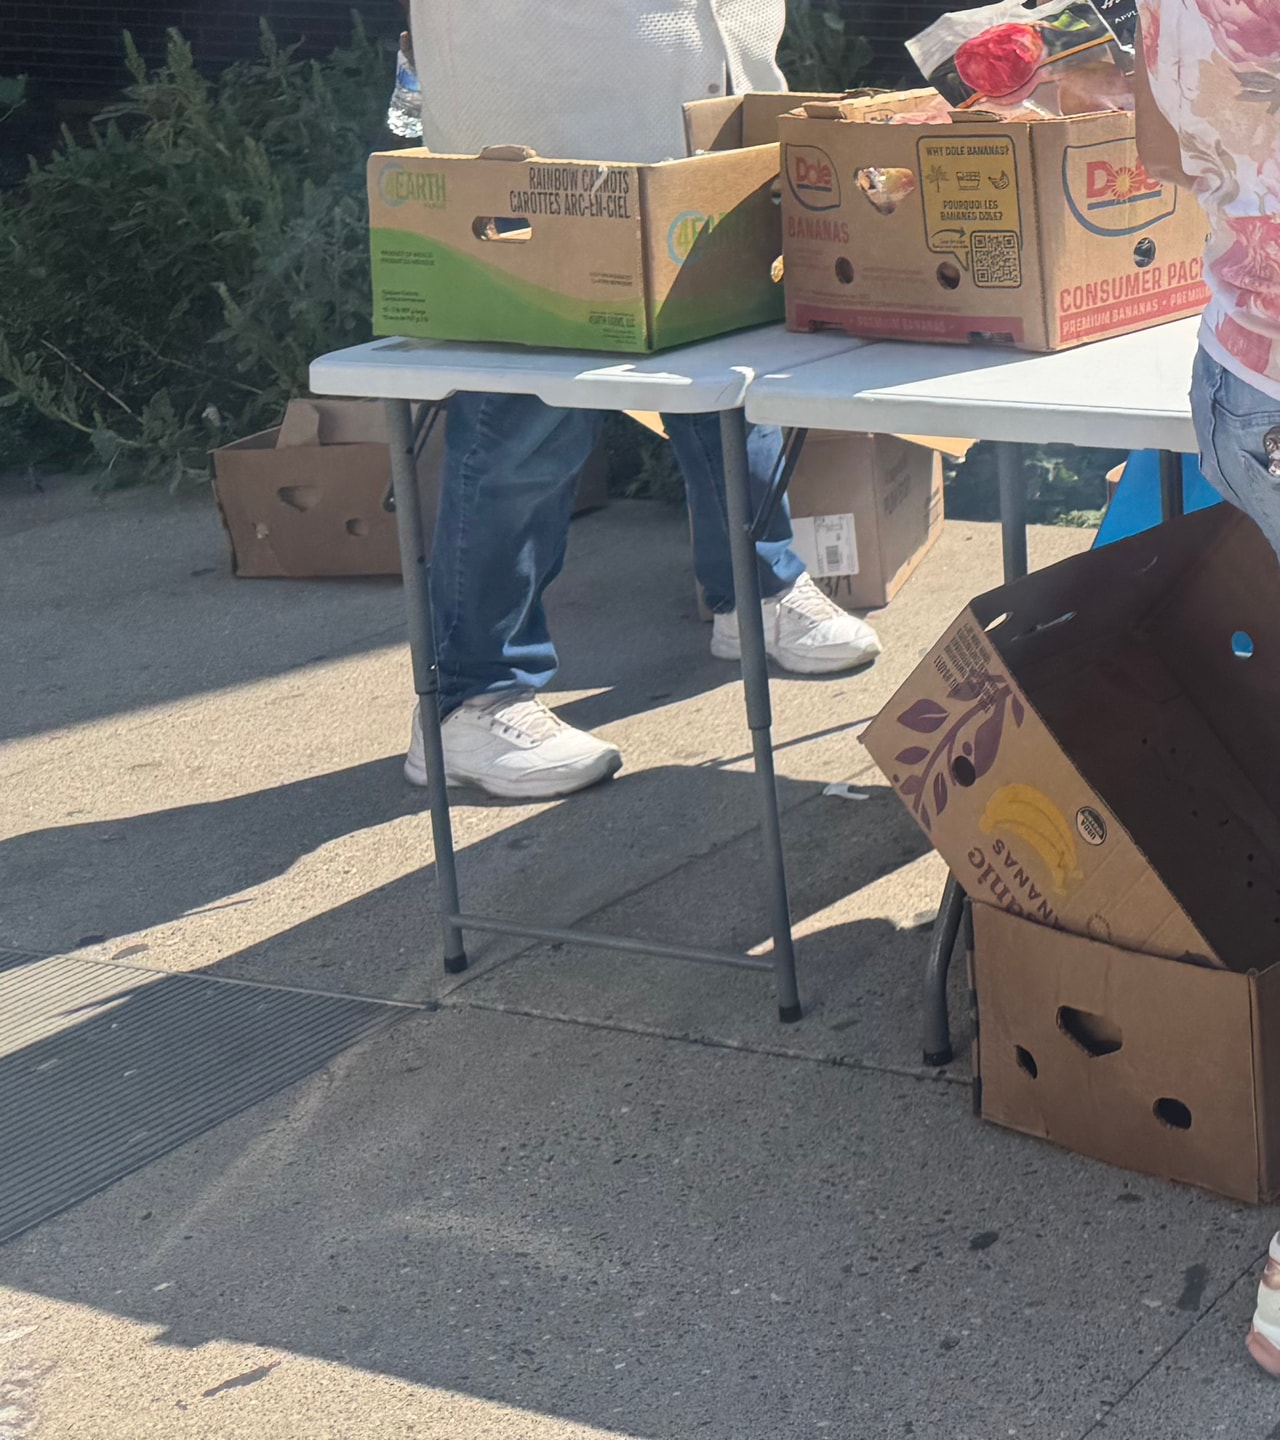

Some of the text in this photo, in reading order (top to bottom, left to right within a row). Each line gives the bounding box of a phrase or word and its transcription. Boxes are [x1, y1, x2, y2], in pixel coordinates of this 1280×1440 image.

[926, 145, 1010, 156] WHY DOLE BANANAS?
[529, 167, 580, 192] RAINBOW
[795, 156, 832, 187] Dole
[510, 190, 631, 219] CAROTTES ARC-EN-CIEL
[984, 199, 999, 209] LES
[788, 216, 850, 244] BANANAS
[1060, 267, 1162, 313] CONSUMER
[1062, 312, 1111, 336] PREMIUM
[1112, 299, 1159, 322] BANANAS
